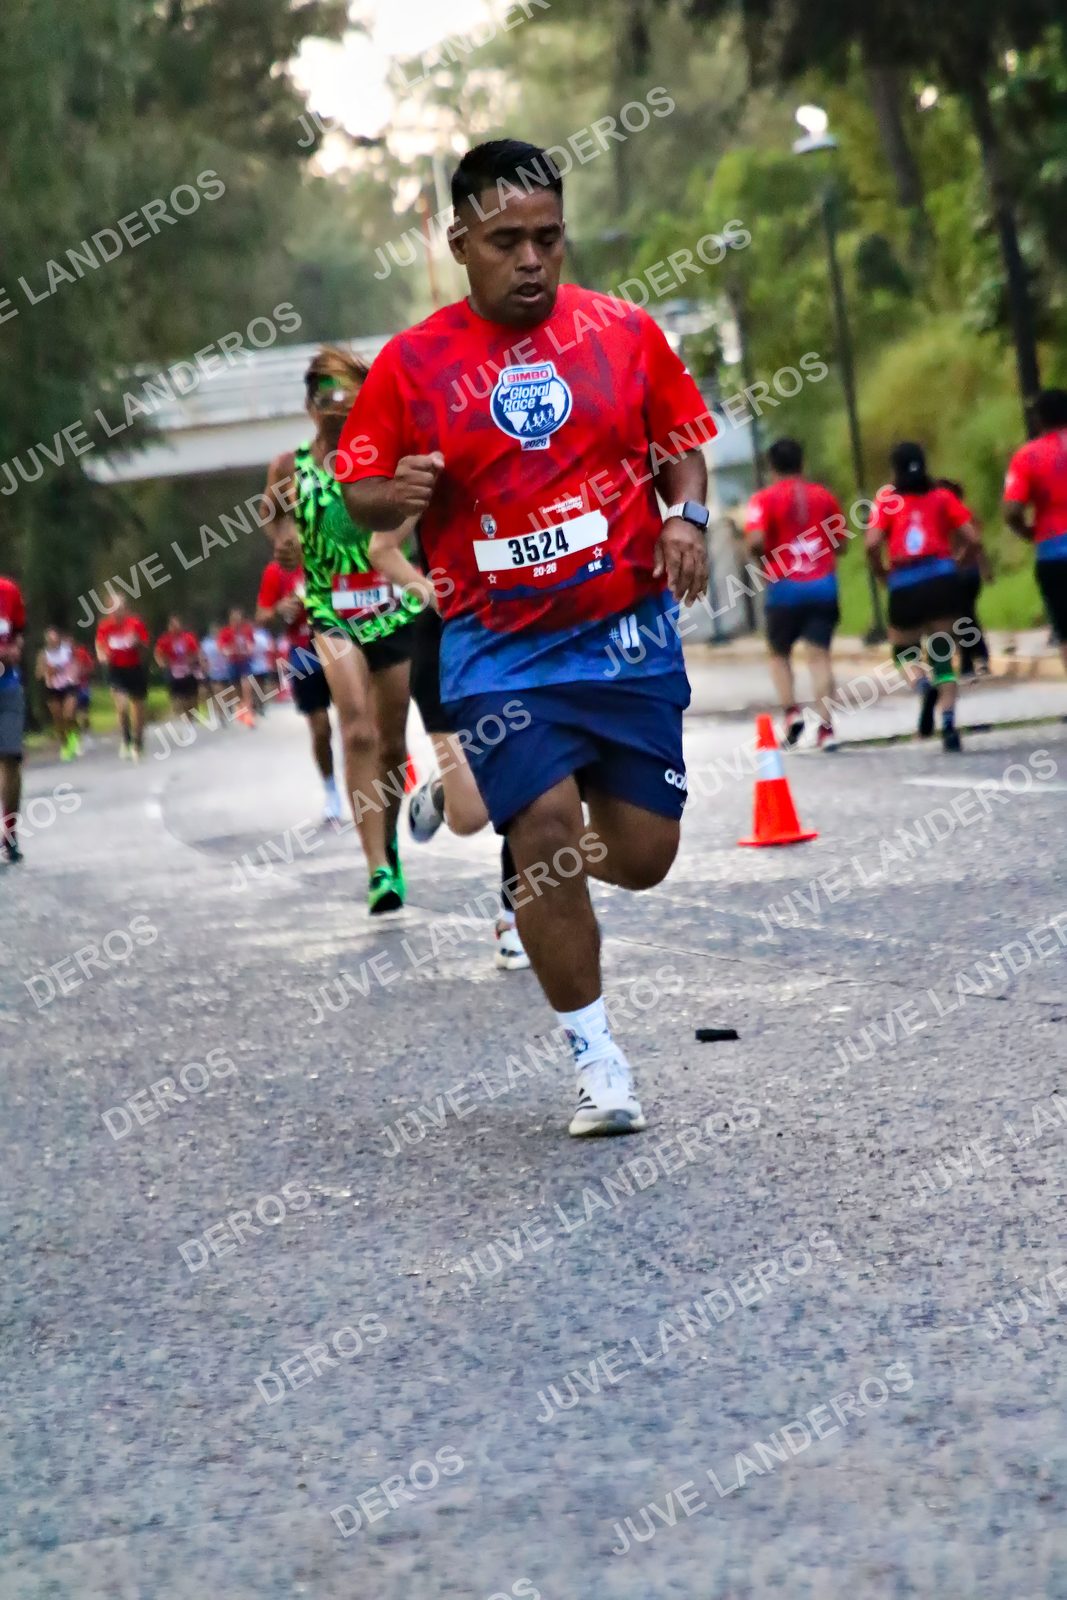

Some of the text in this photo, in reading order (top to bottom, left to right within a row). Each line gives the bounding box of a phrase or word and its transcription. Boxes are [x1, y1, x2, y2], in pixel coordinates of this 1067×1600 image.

[507, 370, 549, 383] BIMBO
[510, 382, 549, 401] Global
[503, 398, 535, 413] Race
[508, 526, 569, 565] 3524
